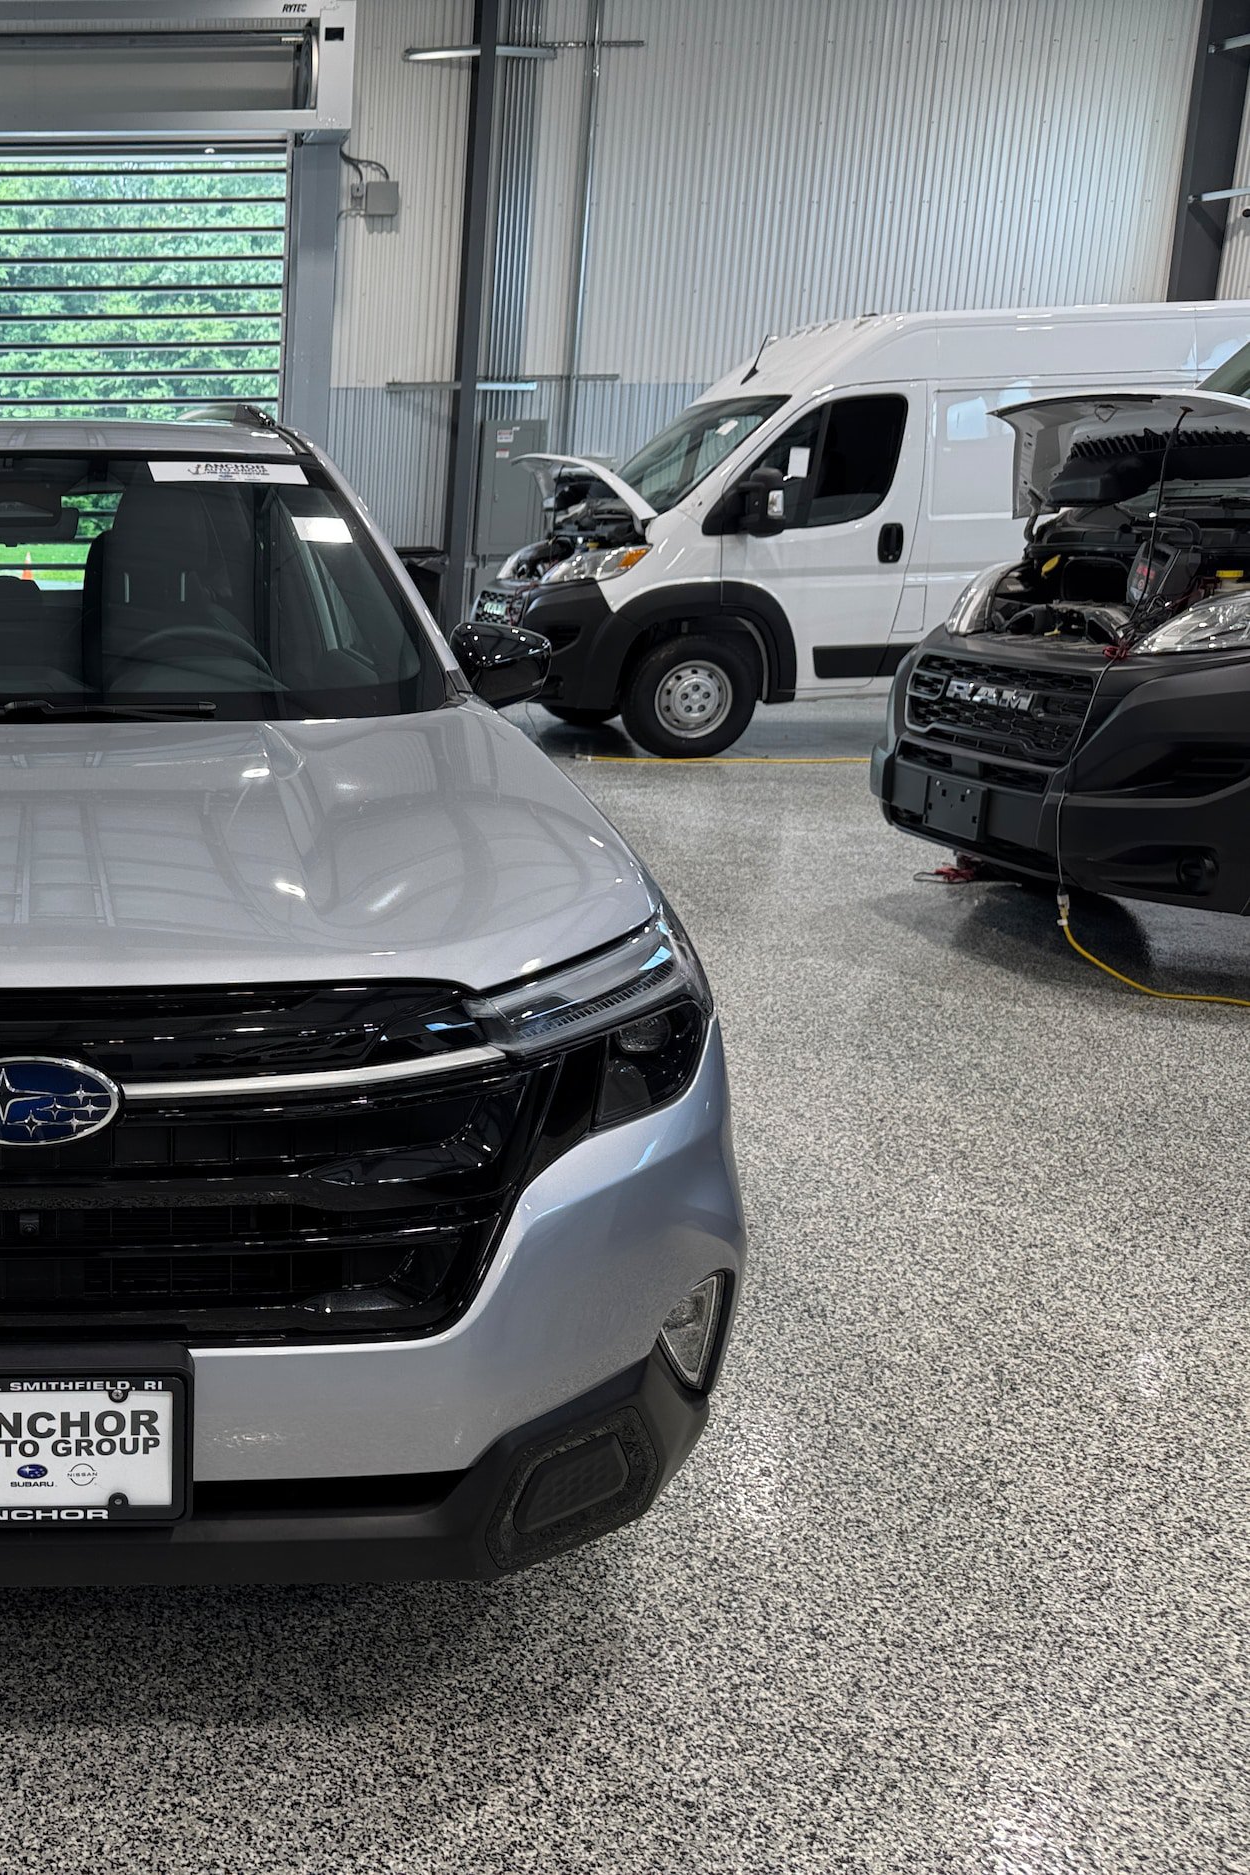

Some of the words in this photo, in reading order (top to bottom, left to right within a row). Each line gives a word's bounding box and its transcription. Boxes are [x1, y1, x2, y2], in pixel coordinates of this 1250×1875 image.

[281, 3, 307, 13] RYTEC
[946, 680, 1034, 711] RAM
[144, 1381, 162, 1390] RI
[51, 1437, 161, 1457] GROUP
